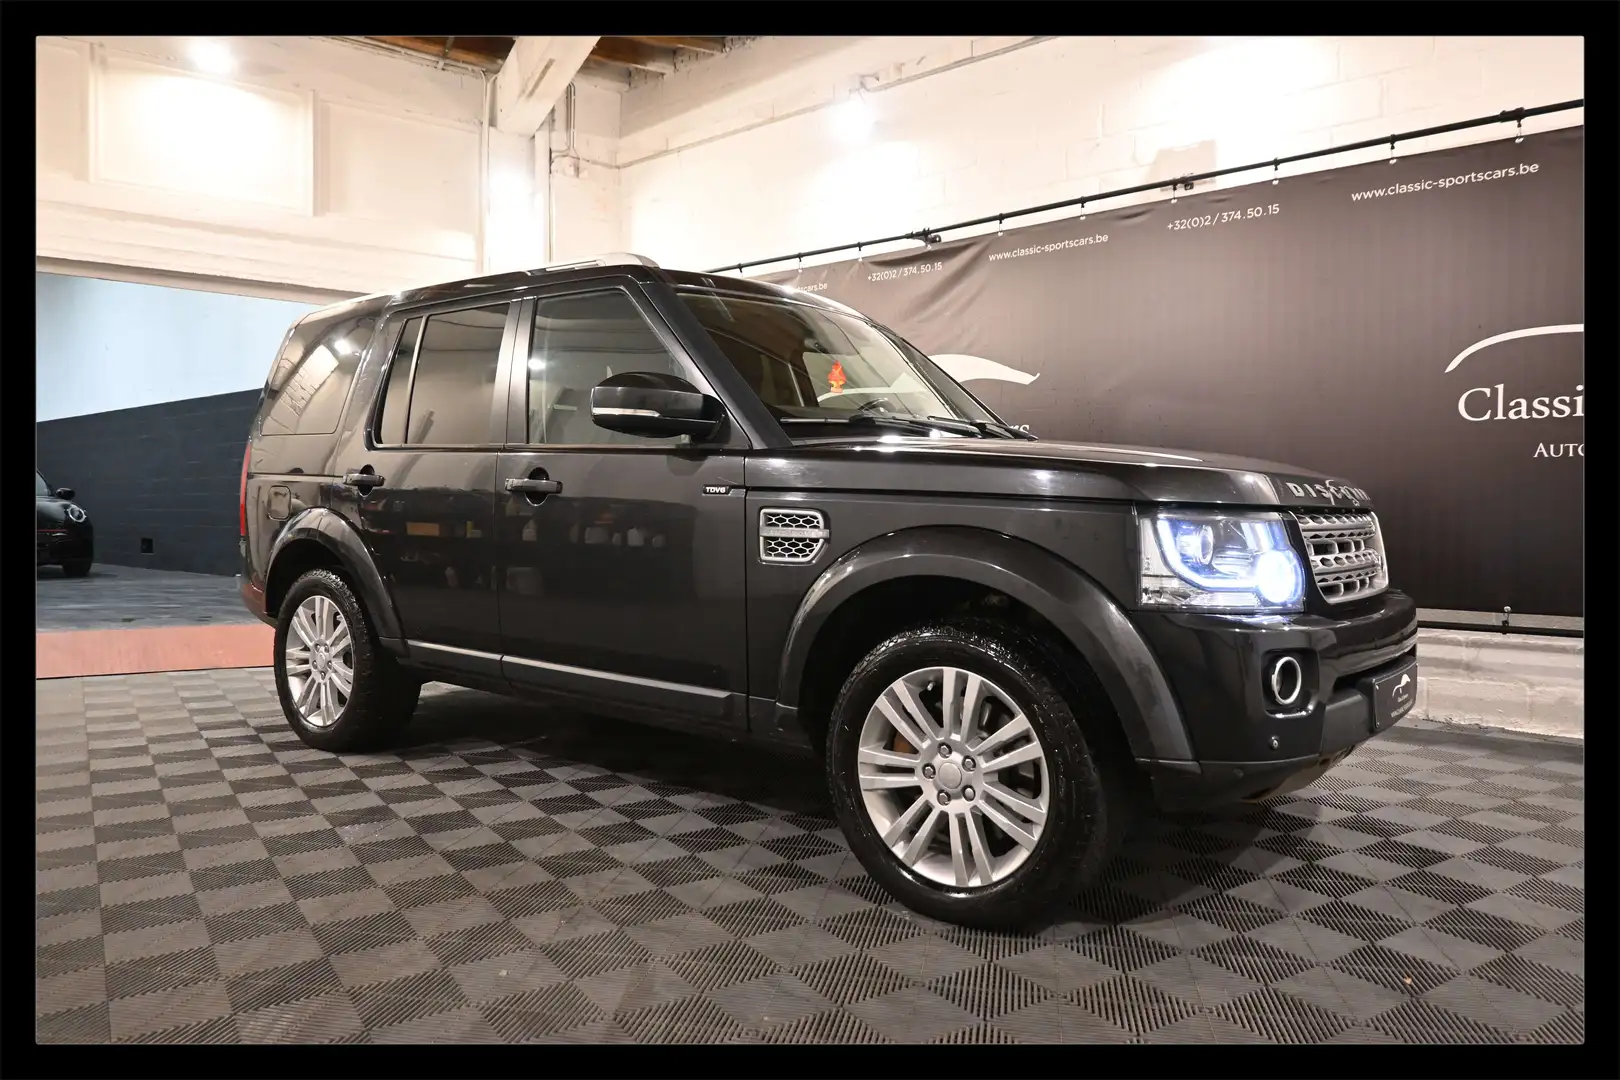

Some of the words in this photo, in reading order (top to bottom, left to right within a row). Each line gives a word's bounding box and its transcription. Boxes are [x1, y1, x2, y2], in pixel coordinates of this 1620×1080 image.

[1351, 163, 1540, 201] www.classic-sportscars.be
[988, 233, 1109, 261] www.classic-sportscars.be
[1458, 383, 1584, 421] Classi
